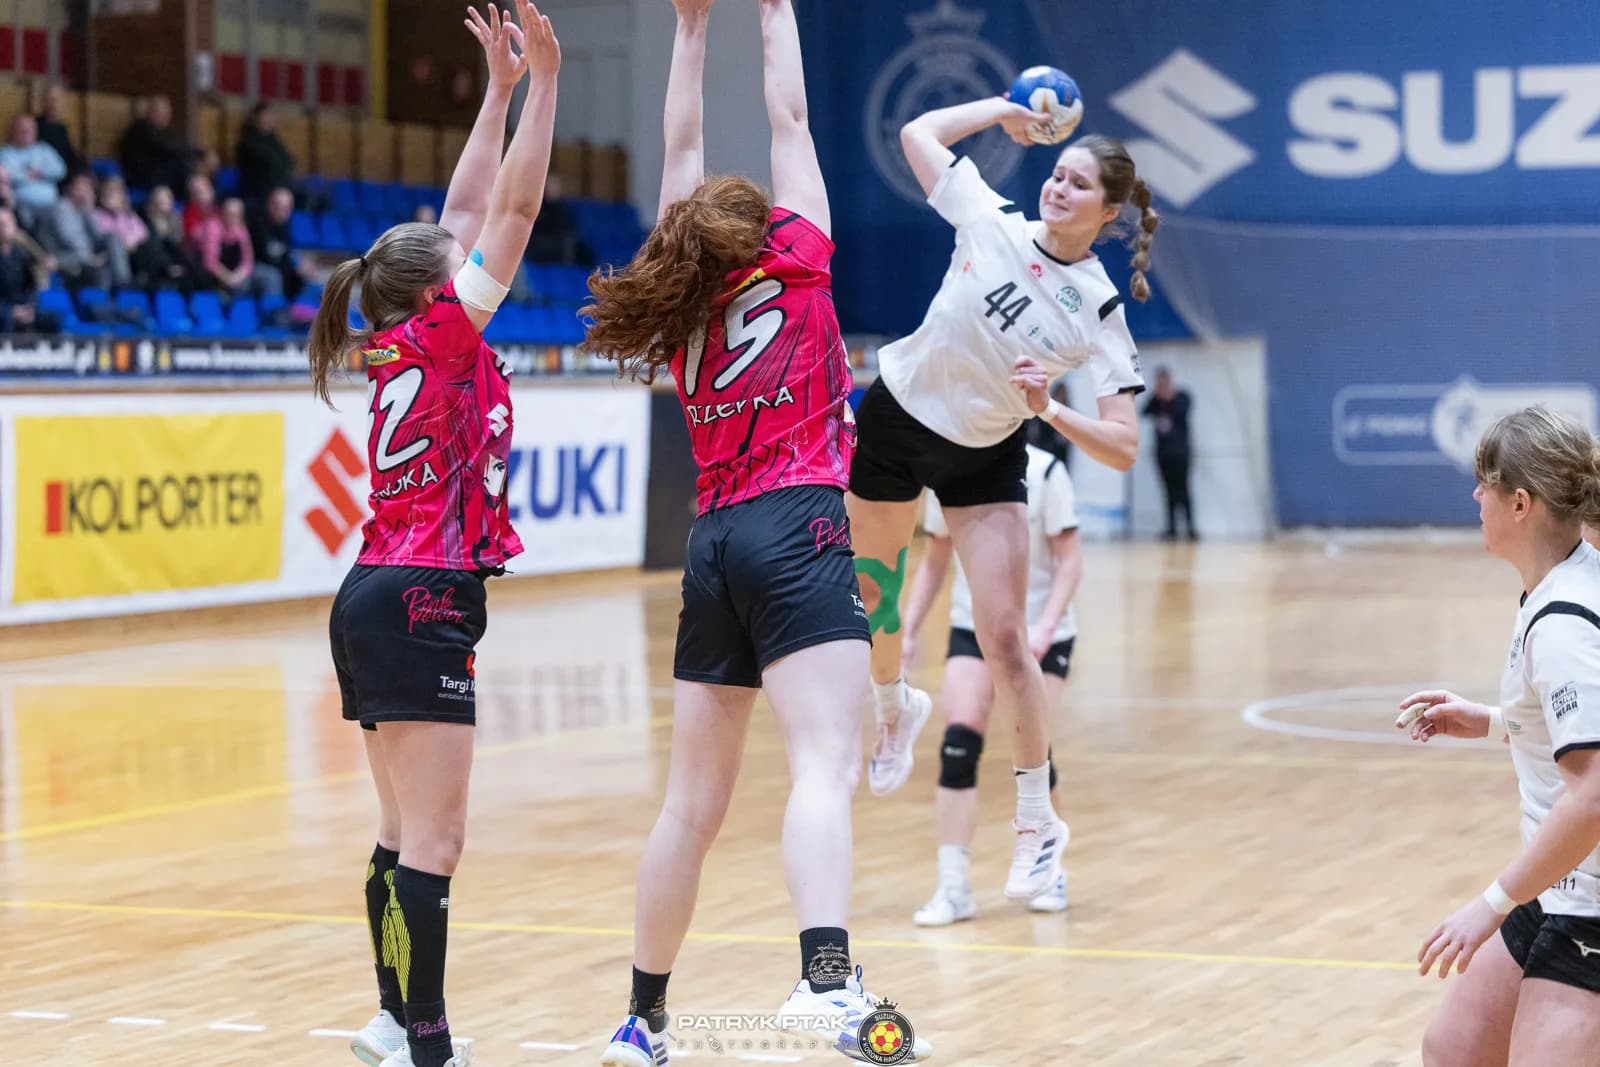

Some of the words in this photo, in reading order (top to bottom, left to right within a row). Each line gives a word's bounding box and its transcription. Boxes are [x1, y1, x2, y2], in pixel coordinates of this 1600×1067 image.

[1288, 65, 1600, 178] SUZ
[984, 281, 1033, 333] 44
[368, 365, 433, 473] 2
[67, 473, 262, 534] KOLPORTER
[402, 586, 456, 616] Pink
[440, 675, 470, 694] Targi
[1556, 700, 1578, 720] WEAR
